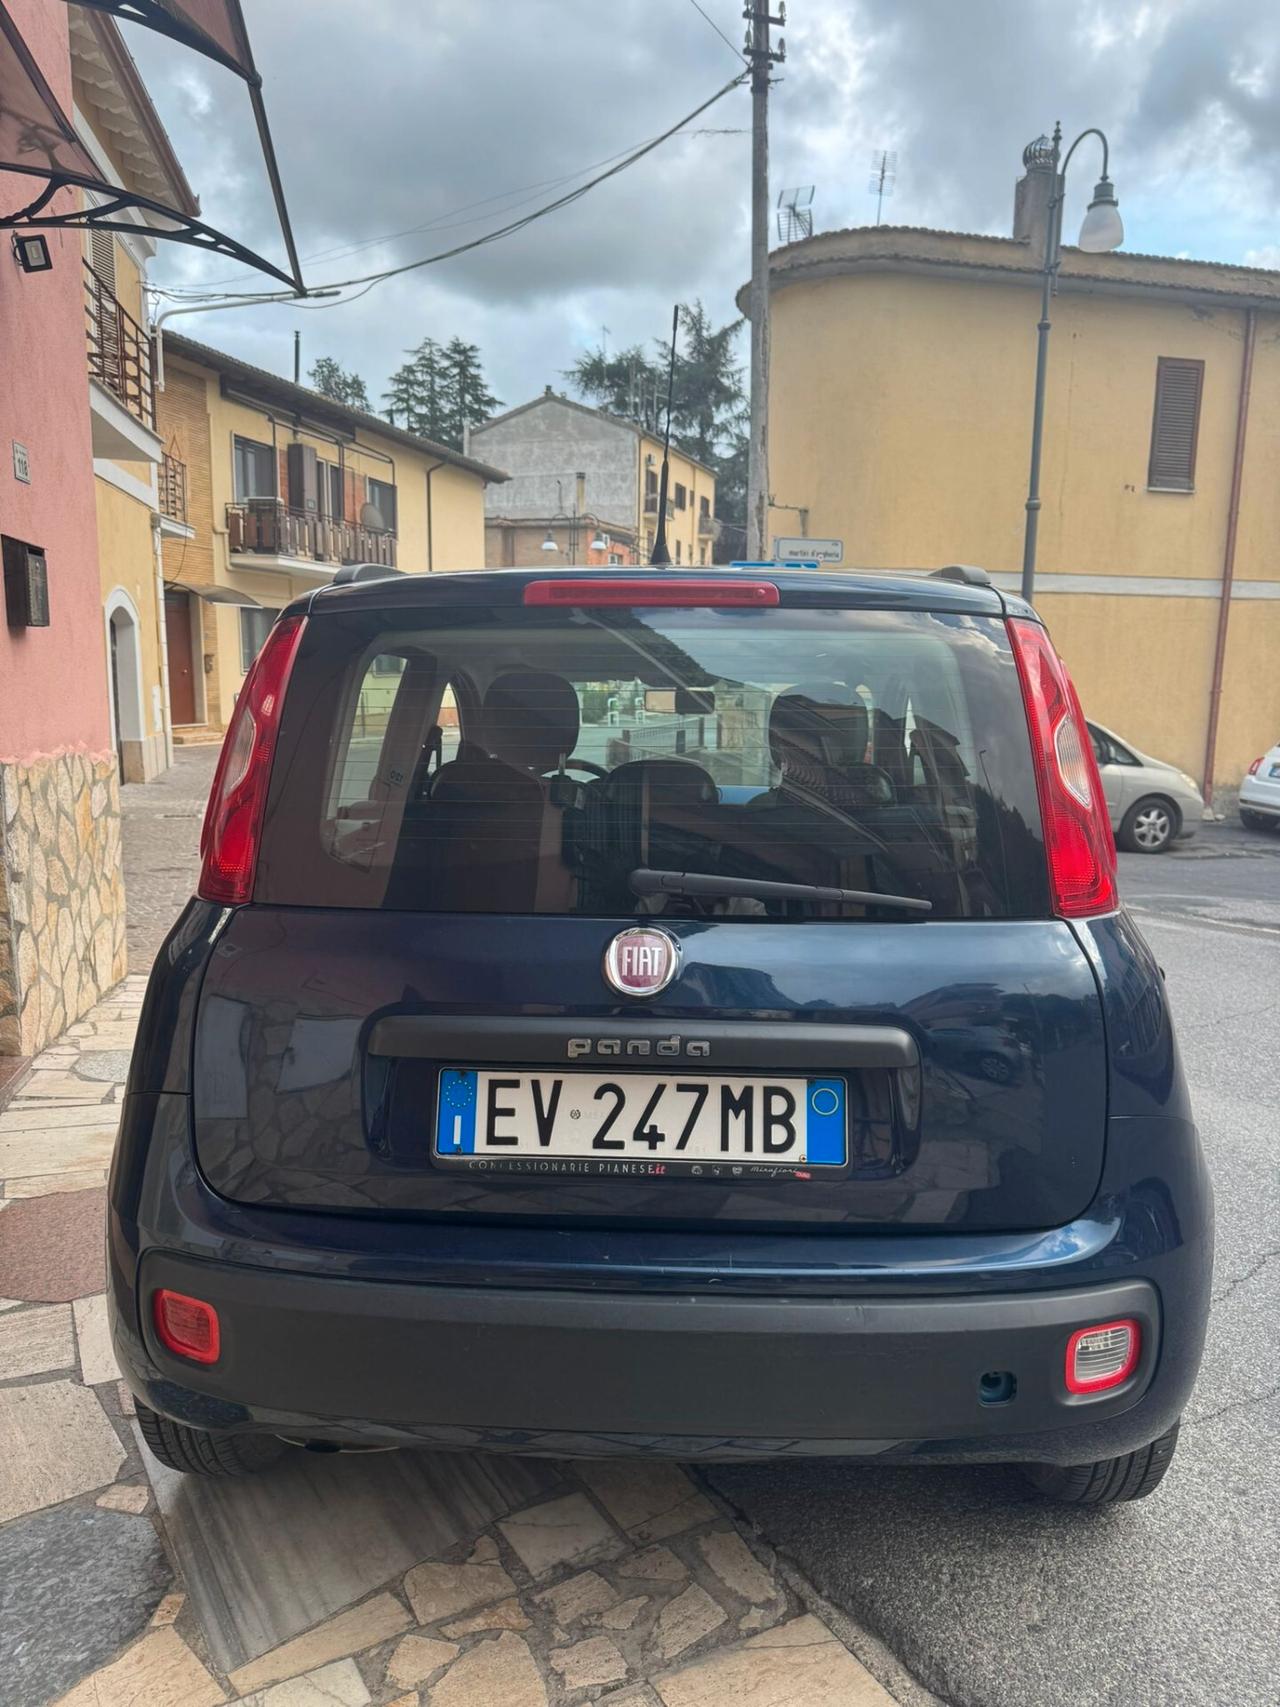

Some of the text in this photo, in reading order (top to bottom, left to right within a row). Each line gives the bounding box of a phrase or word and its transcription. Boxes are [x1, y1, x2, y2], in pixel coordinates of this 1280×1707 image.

[621, 946, 662, 976] FIAT
[567, 1035, 710, 1058] panda
[453, 1115, 462, 1145] I
[486, 1079, 797, 1154] EV 247MB
[468, 1160, 590, 1173] CONESSIONARIE
